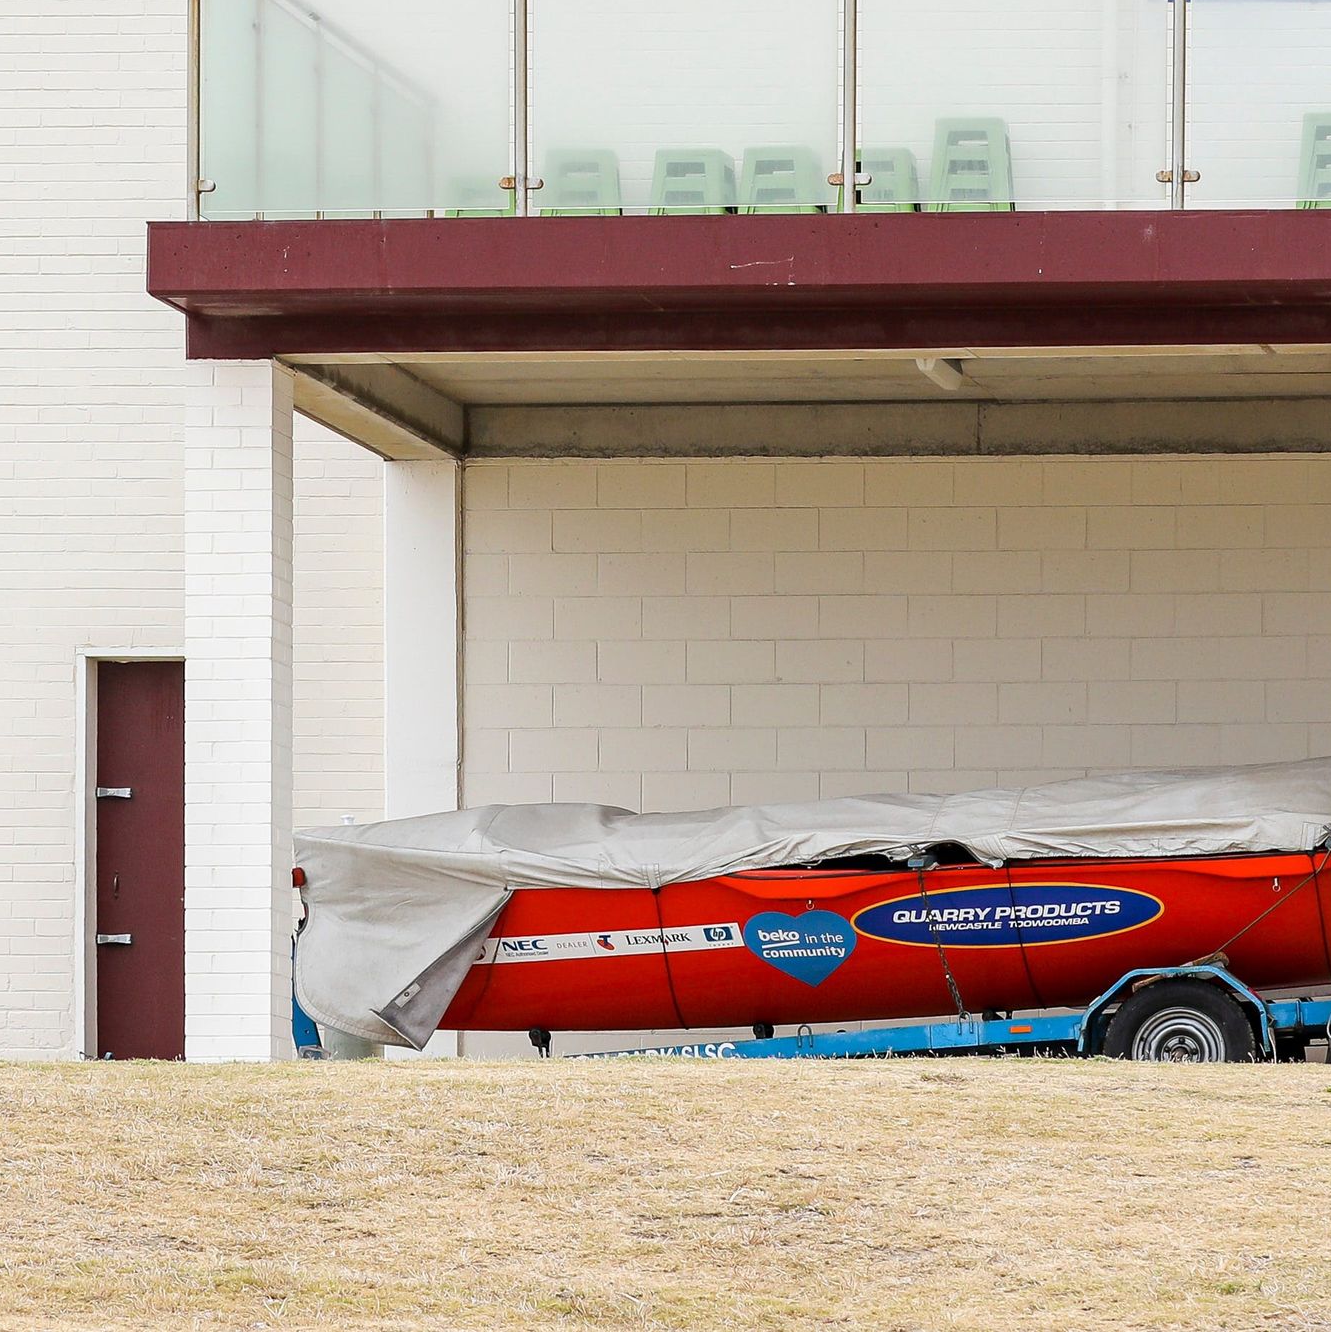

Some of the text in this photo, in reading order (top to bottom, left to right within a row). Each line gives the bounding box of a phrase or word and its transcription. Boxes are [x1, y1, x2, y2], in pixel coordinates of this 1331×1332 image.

[893, 900, 1121, 924] QUARRY PRODUCTS
[1008, 917, 1089, 929] TOOWOOMBA
[625, 932, 693, 946] LEXMARK
[758, 929, 844, 944] beko in the
[501, 939, 548, 951] NEC
[556, 941, 588, 949] DEALER
[762, 946, 846, 958] community
